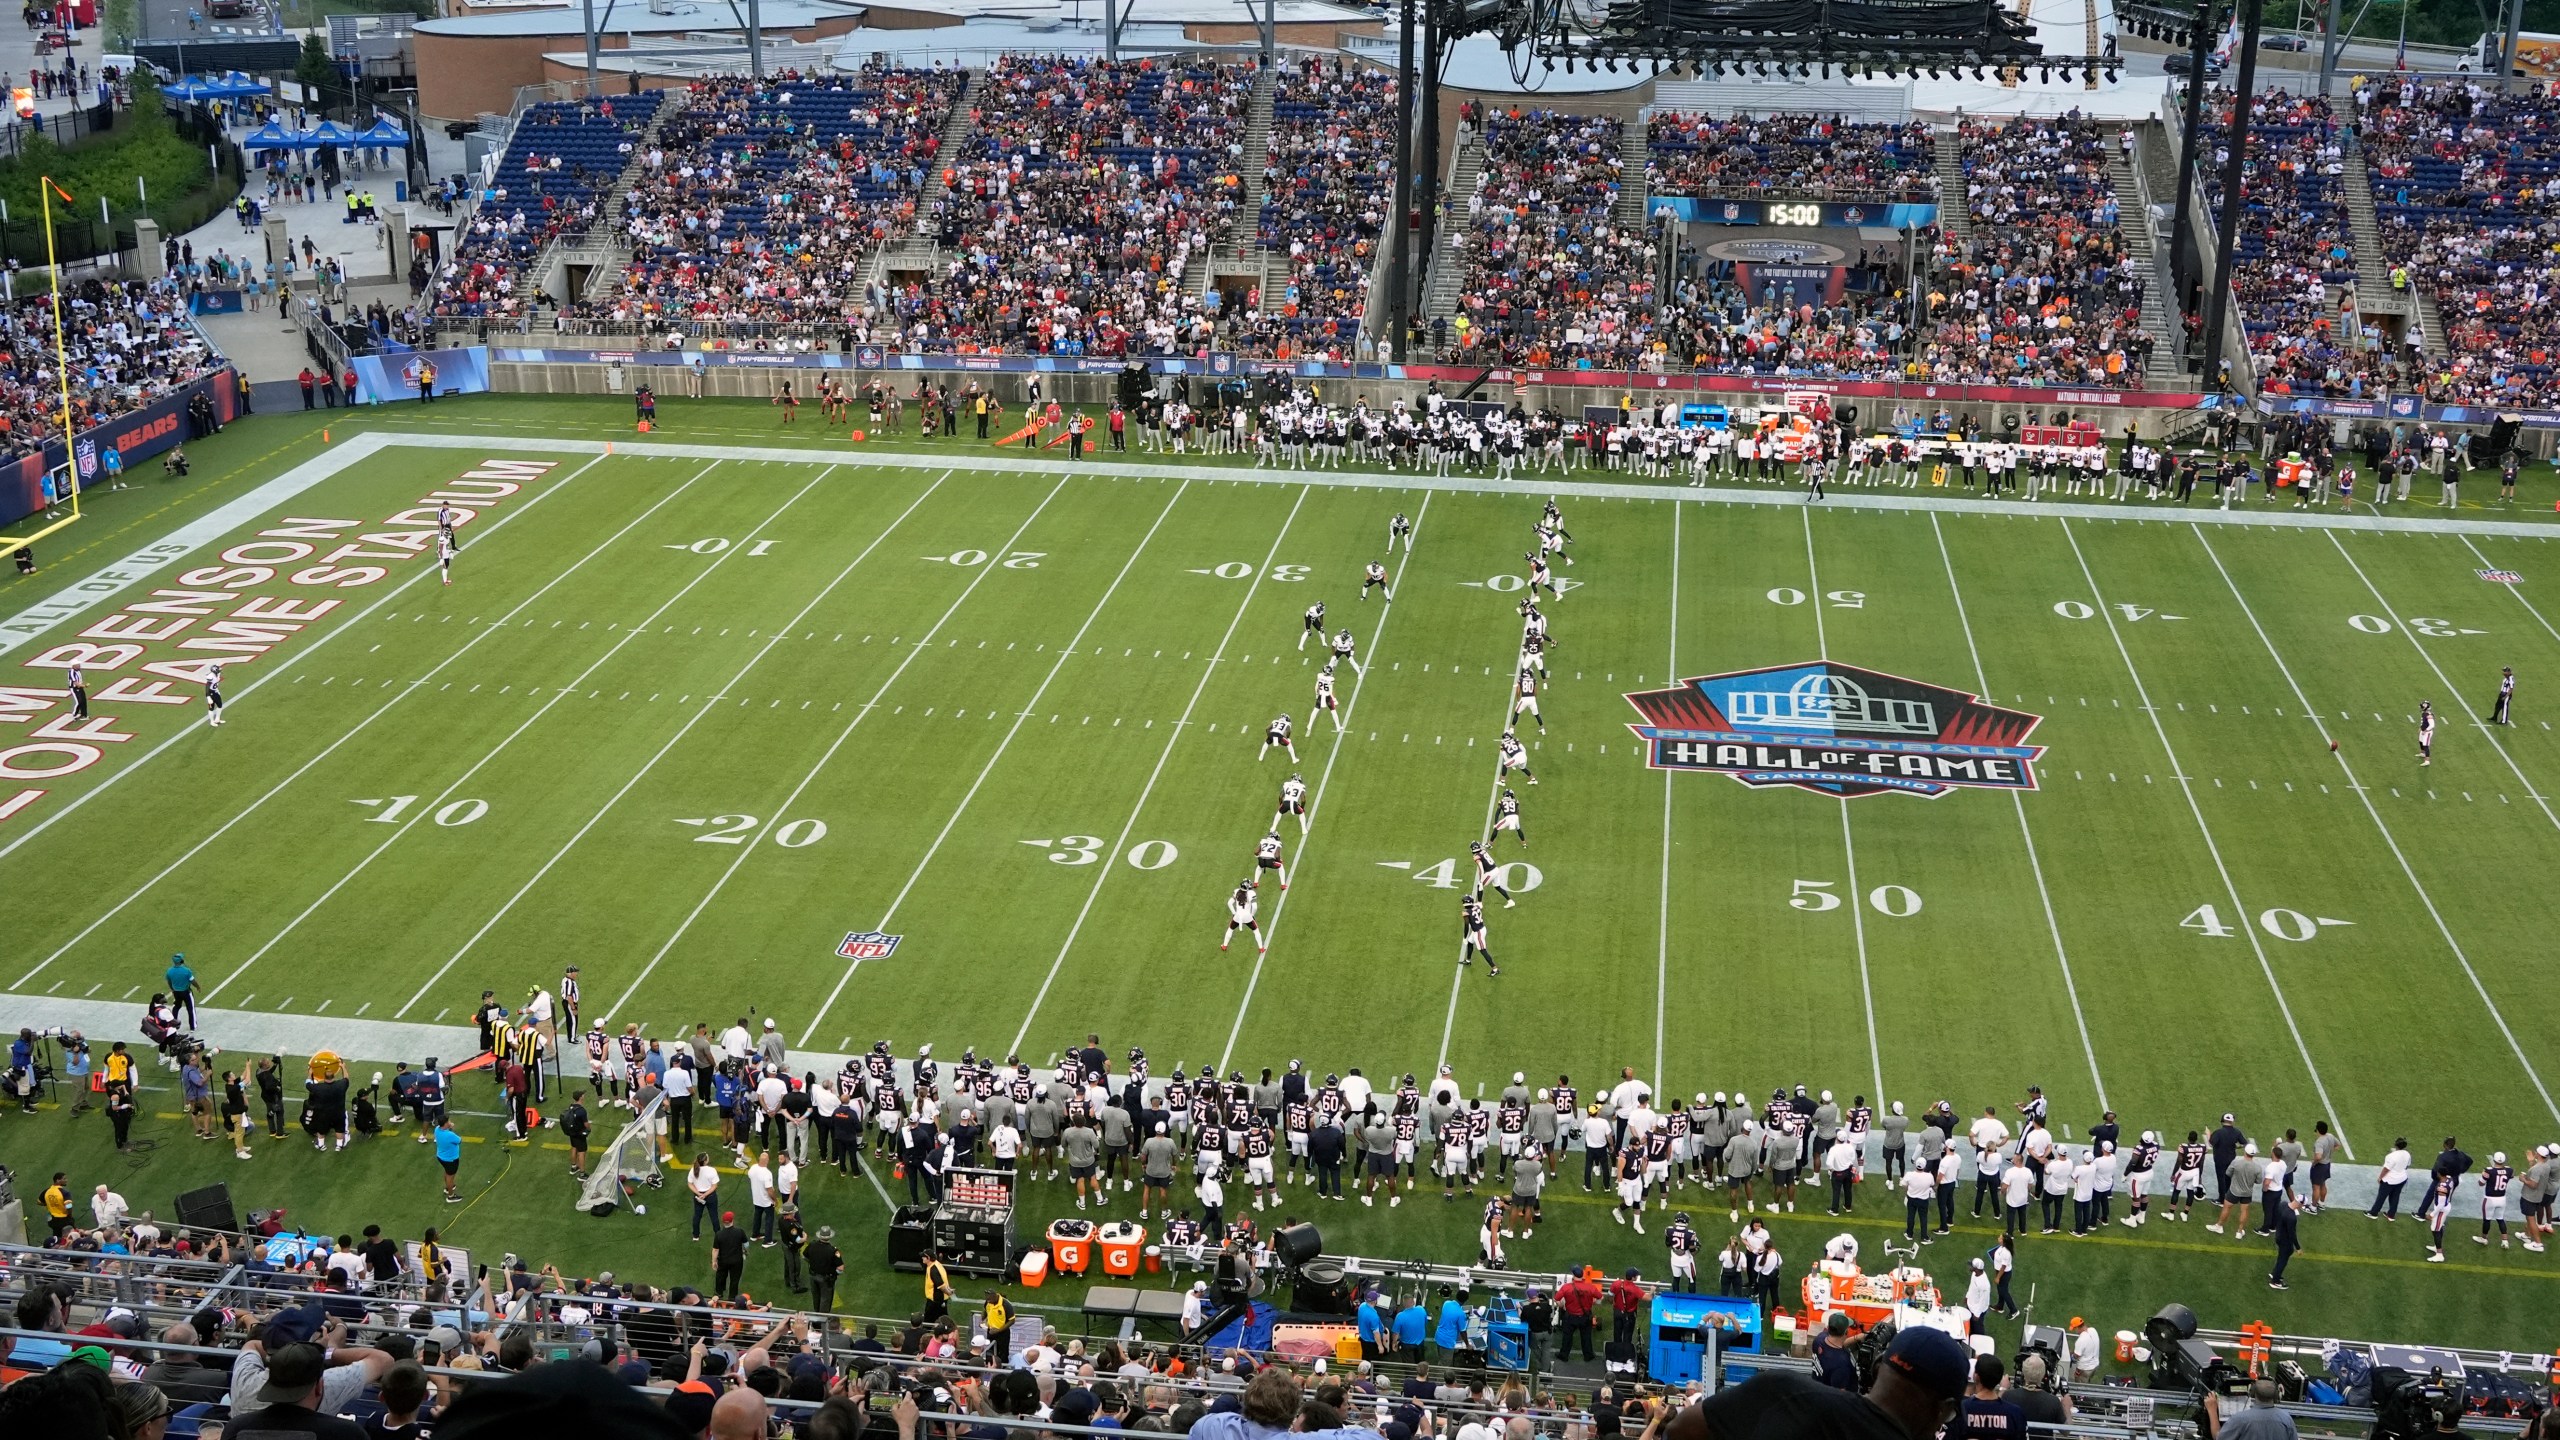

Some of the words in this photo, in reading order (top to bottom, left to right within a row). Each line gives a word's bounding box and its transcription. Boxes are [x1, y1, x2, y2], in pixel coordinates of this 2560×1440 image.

[1769, 204, 1820, 226] 15:00
[1764, 268, 1772, 277] PRO
[1772, 269, 1791, 278] FOOTBALL
[1807, 269, 1819, 278] FAME
[2056, 391, 2080, 402] NATIONAL
[2081, 392, 2104, 403] FOOTBALL
[2104, 393, 2121, 404] LEAGUE
[116, 412, 178, 453] BEARS
[81, 457, 97, 477] NFL
[1935, 470, 1942, 481] 11
[8, 598, 90, 634] ALL
[78, 569, 134, 594] OF
[139, 542, 190, 568] US
[23, 517, 364, 671] BENSON
[0, 714, 138, 780] OF
[92, 596, 345, 706] FAME
[290, 458, 561, 589] STADIUM
[1528, 642, 1538, 653] 25
[1317, 681, 1329, 693] 26
[1522, 679, 1534, 693] 80
[1505, 741, 1518, 754] 26
[1656, 728, 1754, 742] PRO
[1774, 734, 2021, 757] FOOTBALL
[1667, 742, 1820, 770] HALL
[1820, 751, 1856, 765] OF
[1860, 753, 2016, 781] FAME
[1870, 778, 1930, 790] OHIO
[1503, 801, 1516, 815] 39
[694, 814, 828, 848] 20
[1048, 835, 1178, 870] 30
[1260, 842, 1276, 853] 22
[1789, 879, 1923, 917] 50
[2178, 903, 2318, 942] 40
[843, 942, 887, 958] NFL
[590, 1040, 602, 1055] 48
[622, 1044, 634, 1058] 19
[870, 1062, 886, 1076] 93
[841, 1082, 856, 1096] 67
[976, 1082, 992, 1096] 96
[1014, 1087, 1030, 1101] 59
[879, 1094, 895, 1109] 69
[1170, 1093, 1186, 1107] 30
[1322, 1095, 1339, 1112] 60
[1556, 1097, 1572, 1111] 86
[1193, 1106, 1206, 1121] 74
[1232, 1110, 1248, 1125] 79
[1290, 1115, 1306, 1130] 88
[1471, 1120, 1487, 1133] 24
[1505, 1116, 1520, 1131] 26
[1671, 1122, 1687, 1137] 82
[1853, 1116, 1869, 1132] 37
[1398, 1125, 1414, 1140] 38
[1202, 1133, 1220, 1148] 63
[1449, 1134, 1467, 1147] 78
[1651, 1140, 1665, 1156] 17
[1249, 1141, 1267, 1156] 60
[2185, 1152, 2202, 1167] 37
[2494, 1175, 2508, 1191] 16
[1171, 1228, 1190, 1245] 75
[1671, 1237, 1685, 1250] 21
[1060, 1246, 1078, 1264] G
[1110, 1250, 1128, 1267] G
[592, 1302, 602, 1315] 18
[2249, 1341, 2260, 1375] GATORADE
[1967, 1413, 2007, 1429] PAYTON
